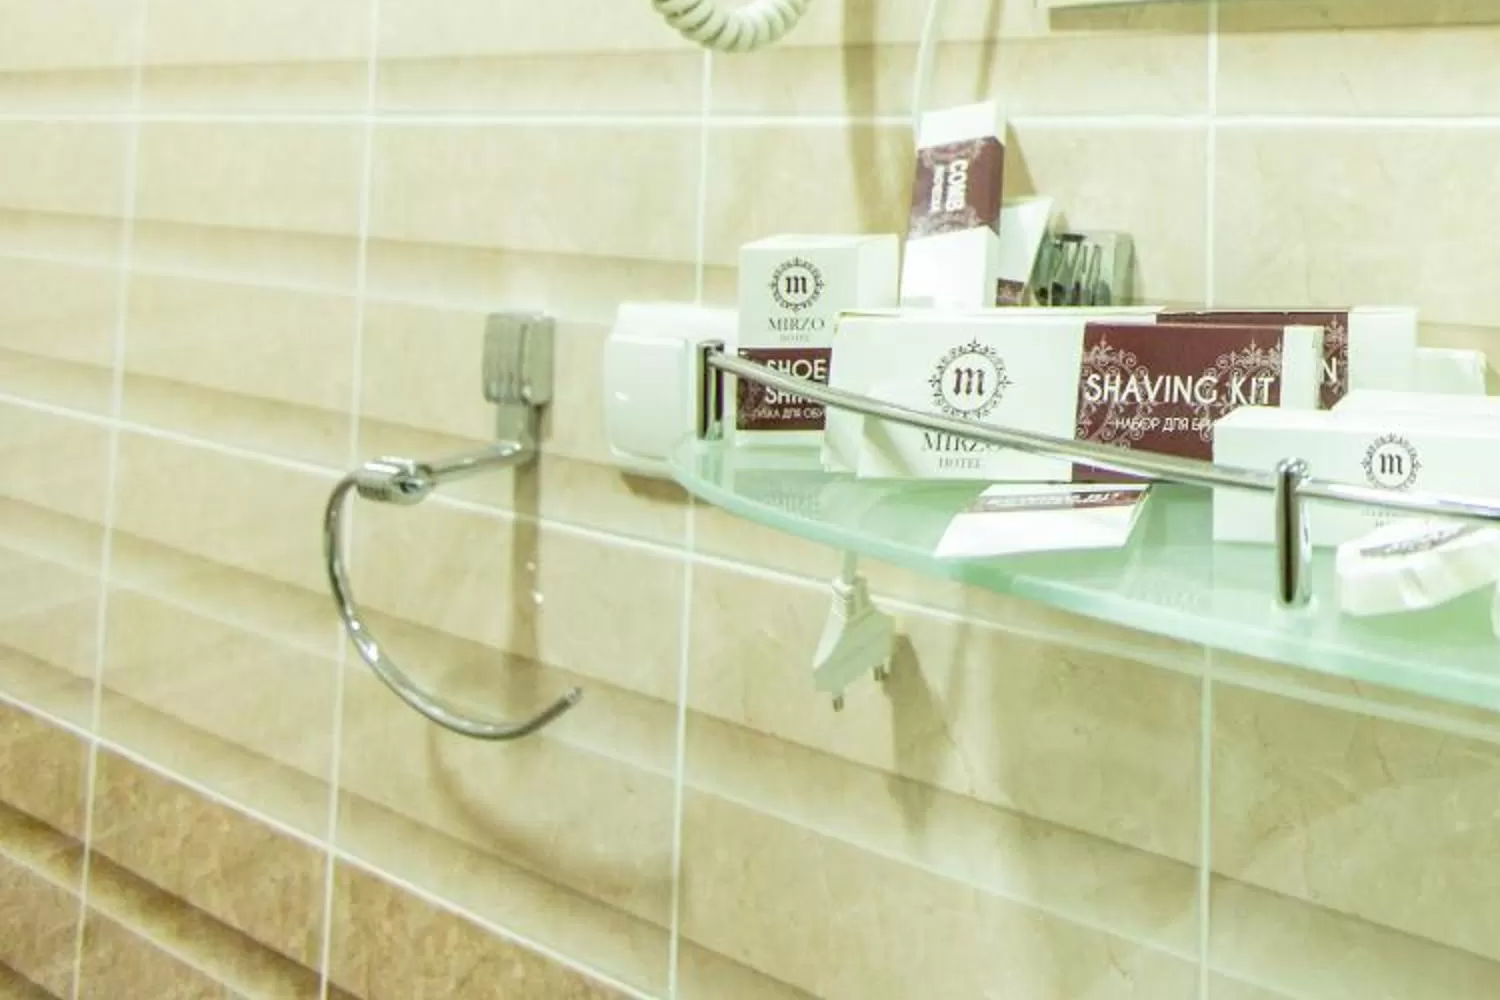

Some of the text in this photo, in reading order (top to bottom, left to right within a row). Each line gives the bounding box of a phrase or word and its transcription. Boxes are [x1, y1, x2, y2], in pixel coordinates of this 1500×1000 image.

[767, 316, 826, 332] MIRZO
[1085, 374, 1276, 405] SHAVING KIT
[1162, 417, 1189, 433] ДЛЯ
[922, 431, 1001, 453] MIRZ
